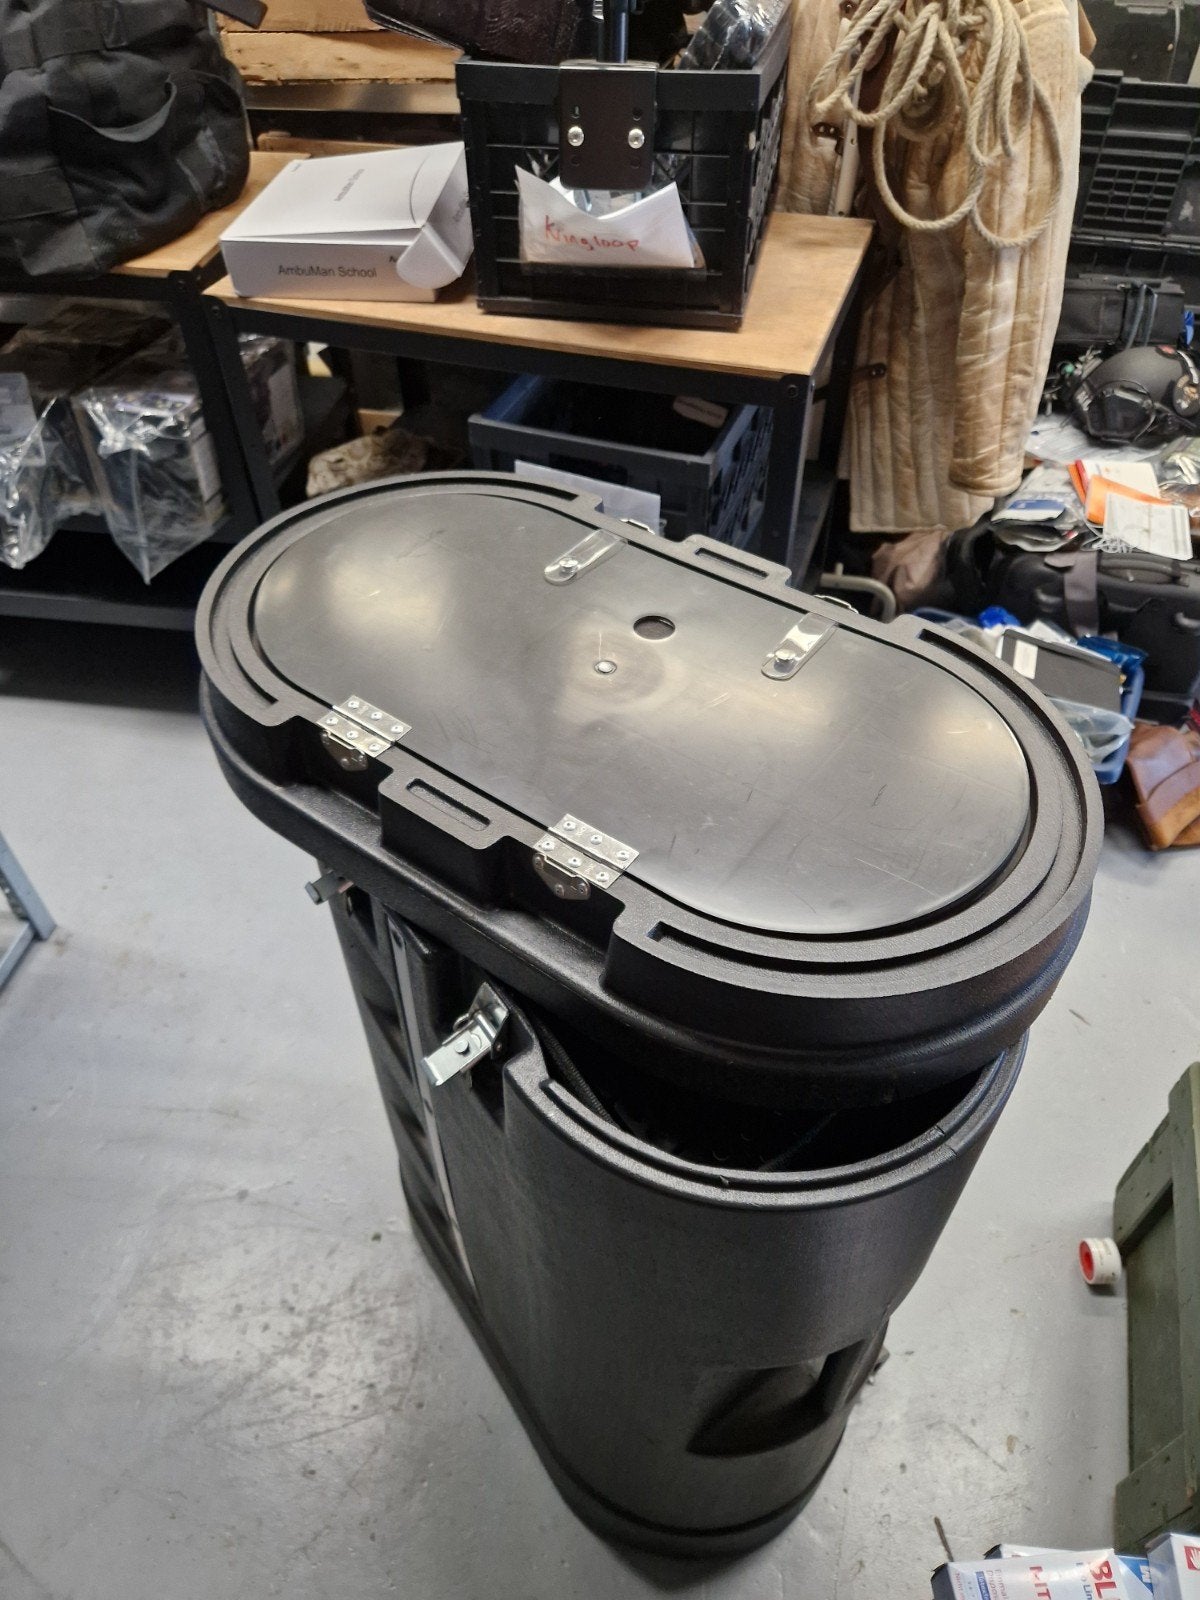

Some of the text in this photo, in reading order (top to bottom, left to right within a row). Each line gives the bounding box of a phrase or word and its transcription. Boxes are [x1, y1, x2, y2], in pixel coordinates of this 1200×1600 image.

[278, 265, 377, 278] AmbuMan School
[1090, 1560, 1117, 1600] BL
